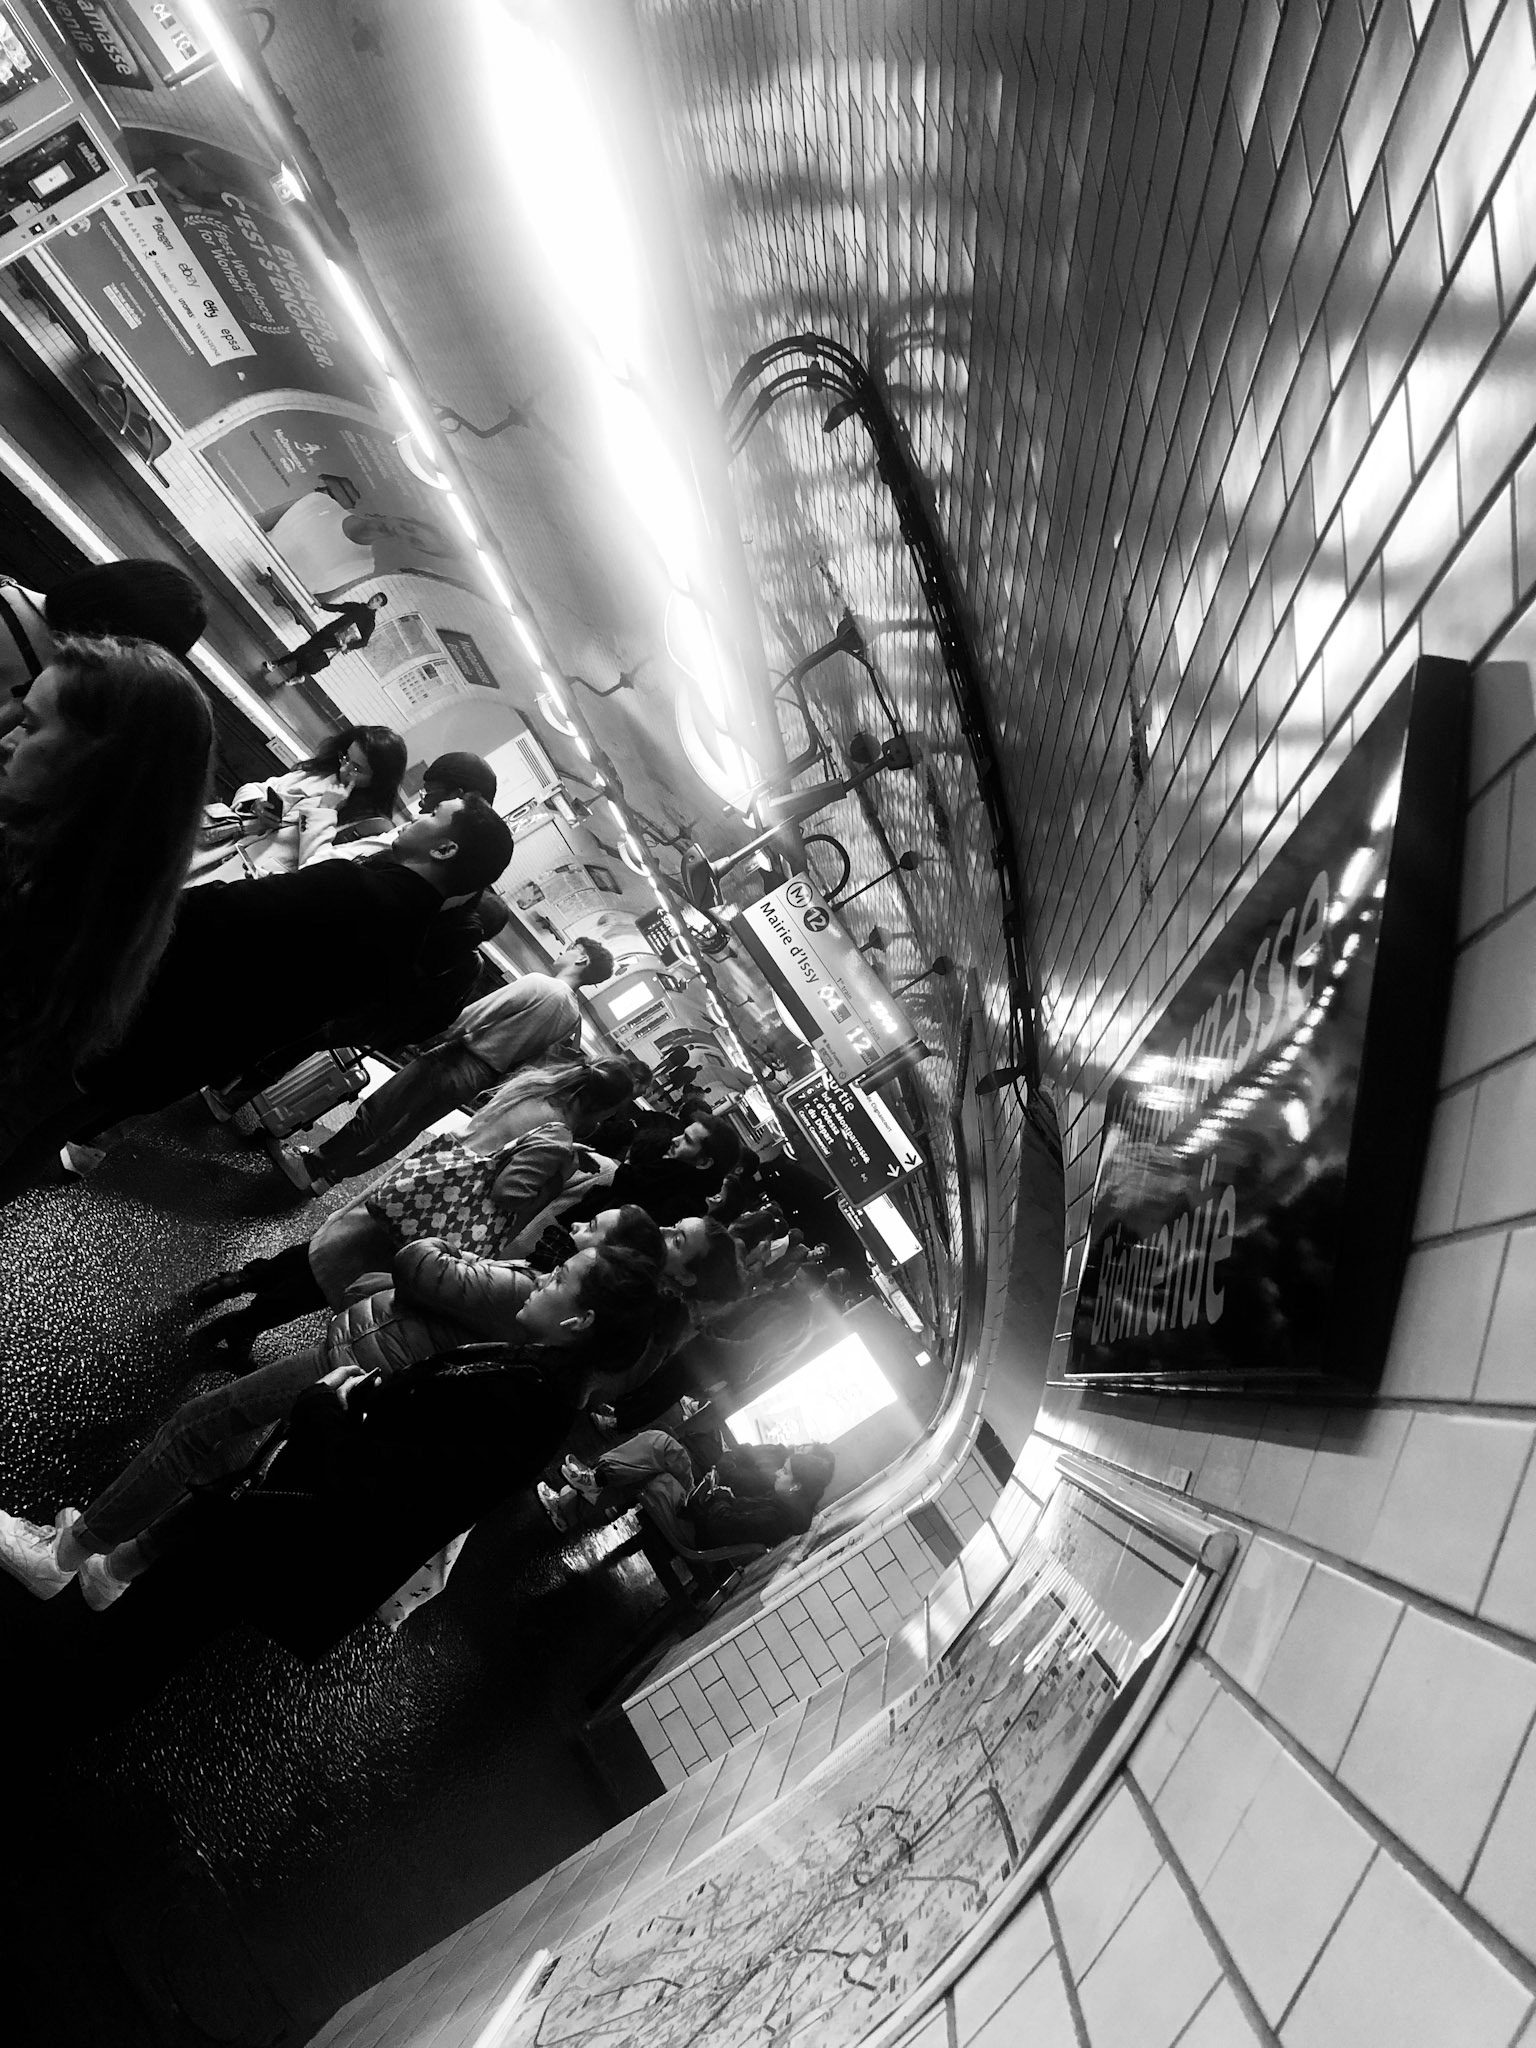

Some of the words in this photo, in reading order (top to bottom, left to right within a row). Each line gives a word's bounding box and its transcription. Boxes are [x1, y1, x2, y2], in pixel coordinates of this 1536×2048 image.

[150, 1, 171, 21] 04
[152, 222, 174, 251] Biogen
[177, 261, 201, 286] ebay
[198, 228, 216, 246] for
[213, 253, 244, 293] Women
[213, 228, 237, 257] Best
[230, 257, 276, 324] Workplaces
[219, 190, 268, 253] C'EST
[256, 255, 334, 369] S'ENGAGER.
[271, 245, 339, 344] ENGAGER,
[220, 325, 242, 351] epsa
[759, 900, 797, 946] Mairie
[804, 907, 827, 931] 12
[817, 982, 845, 1012] 04
[831, 1008, 845, 1022] min
[841, 985, 853, 999] train
[846, 1026, 873, 1054] 12
[860, 1050, 873, 1064] min
[869, 1026, 881, 1040] train
[797, 1092, 805, 1100] 7
[806, 1107, 818, 1120] du
[813, 1118, 834, 1145] Départ
[805, 1086, 814, 1095] 6
[815, 1101, 841, 1135] d'Odessa
[820, 1090, 832, 1103] bd
[827, 1101, 840, 1114] du
[834, 1112, 871, 1164] Montparnasse
[869, 1102, 893, 1131] Clignancourt
[1091, 1154, 1236, 1345] Bienvenüe
[893, 1293, 914, 1321] Alarme
